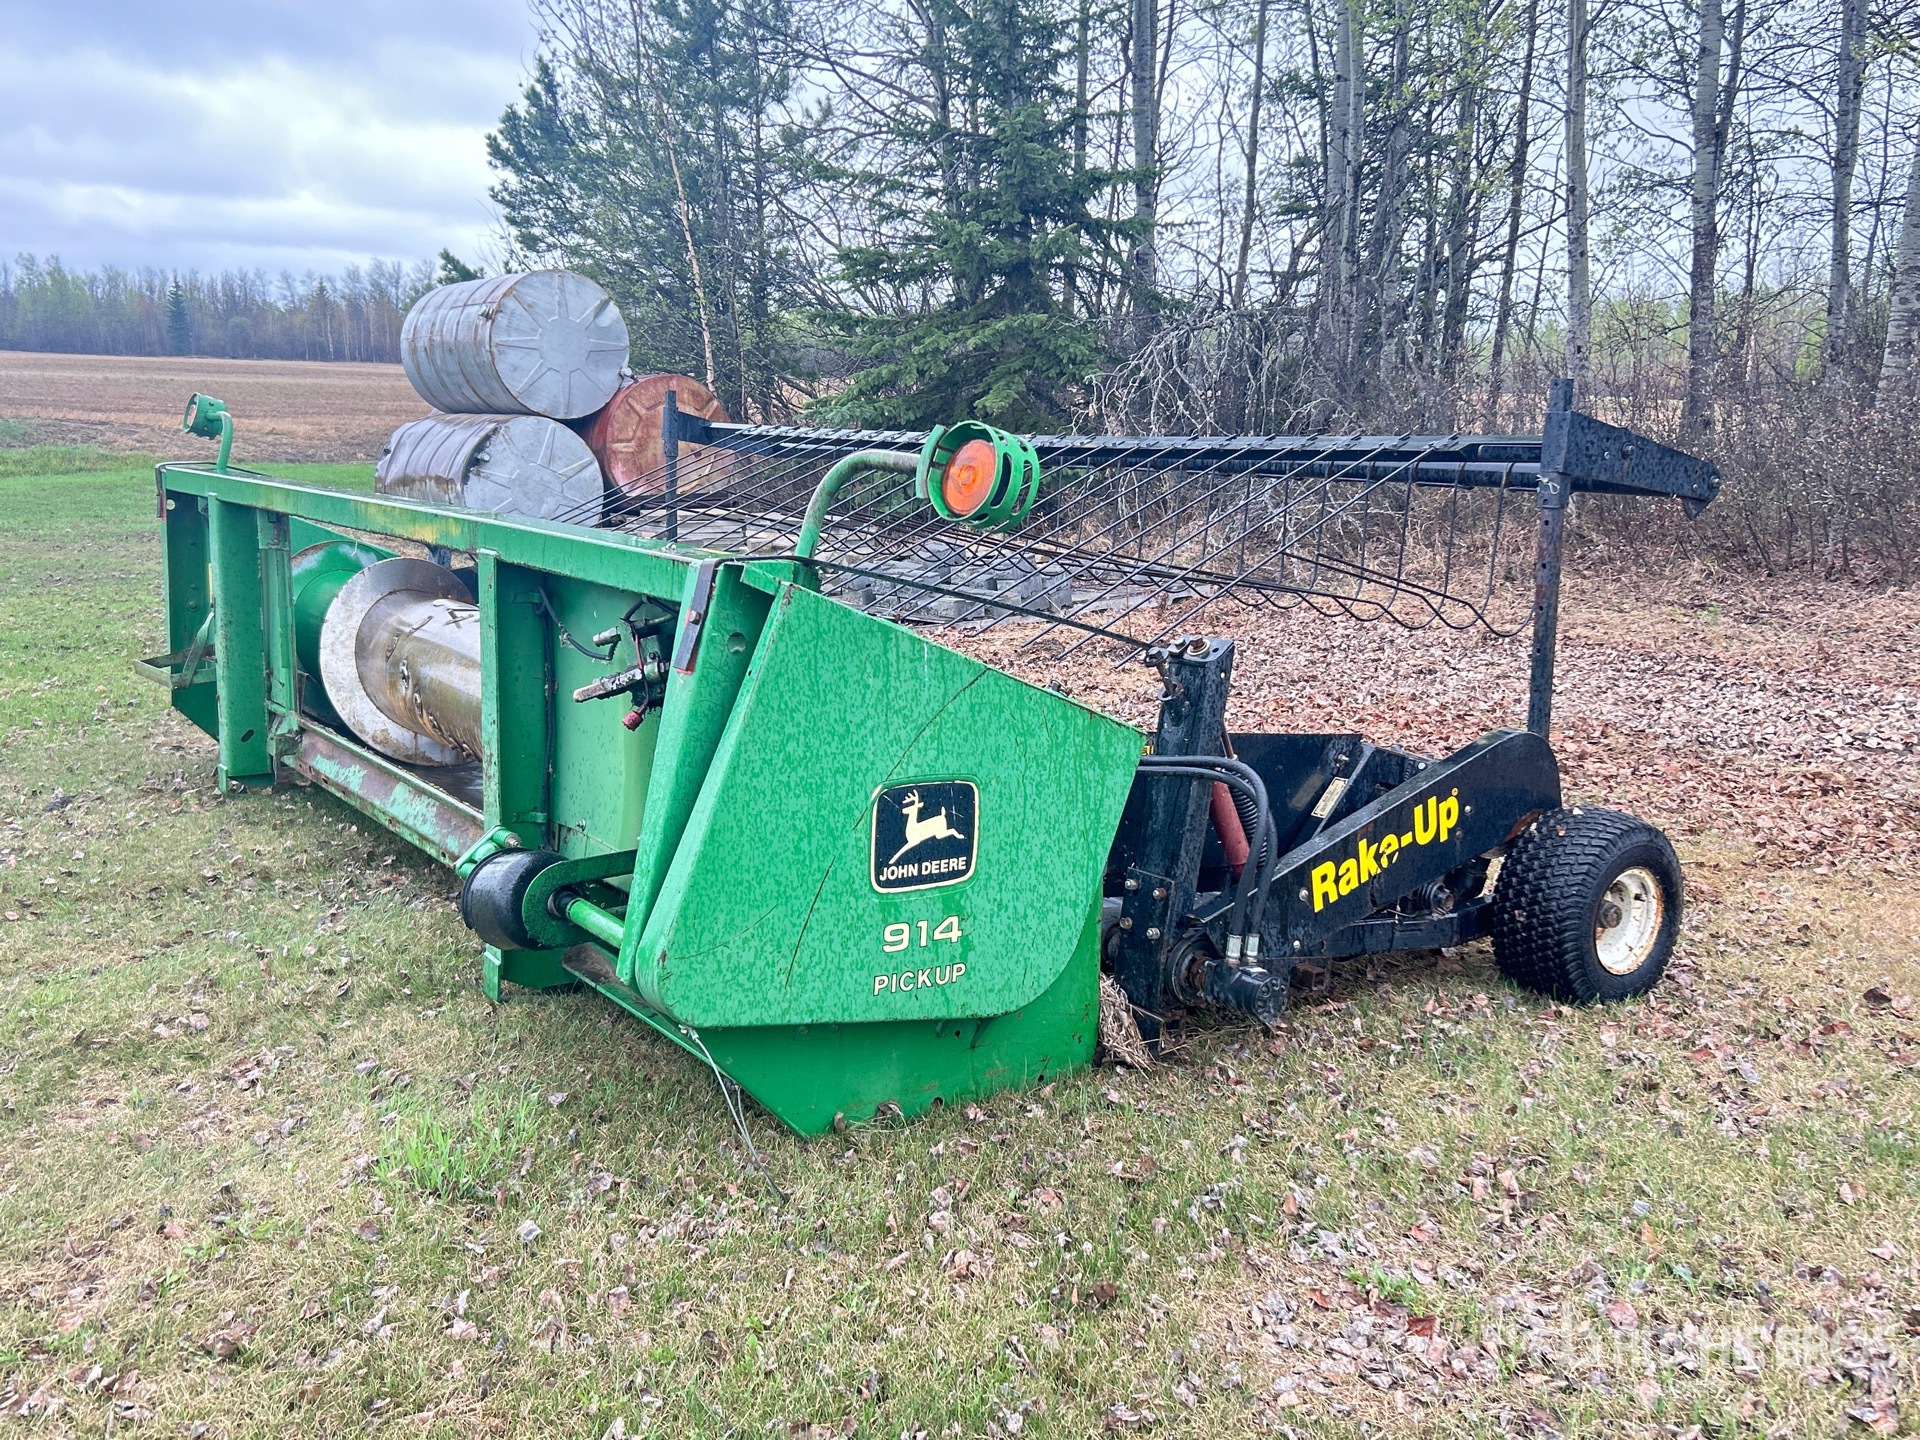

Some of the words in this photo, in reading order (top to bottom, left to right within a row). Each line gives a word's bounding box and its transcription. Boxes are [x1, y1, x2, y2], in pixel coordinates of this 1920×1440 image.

[879, 863, 918, 882] JOHN
[921, 857, 967, 876] DEERE
[882, 915, 963, 953] 914
[873, 962, 967, 996] PICKUP
